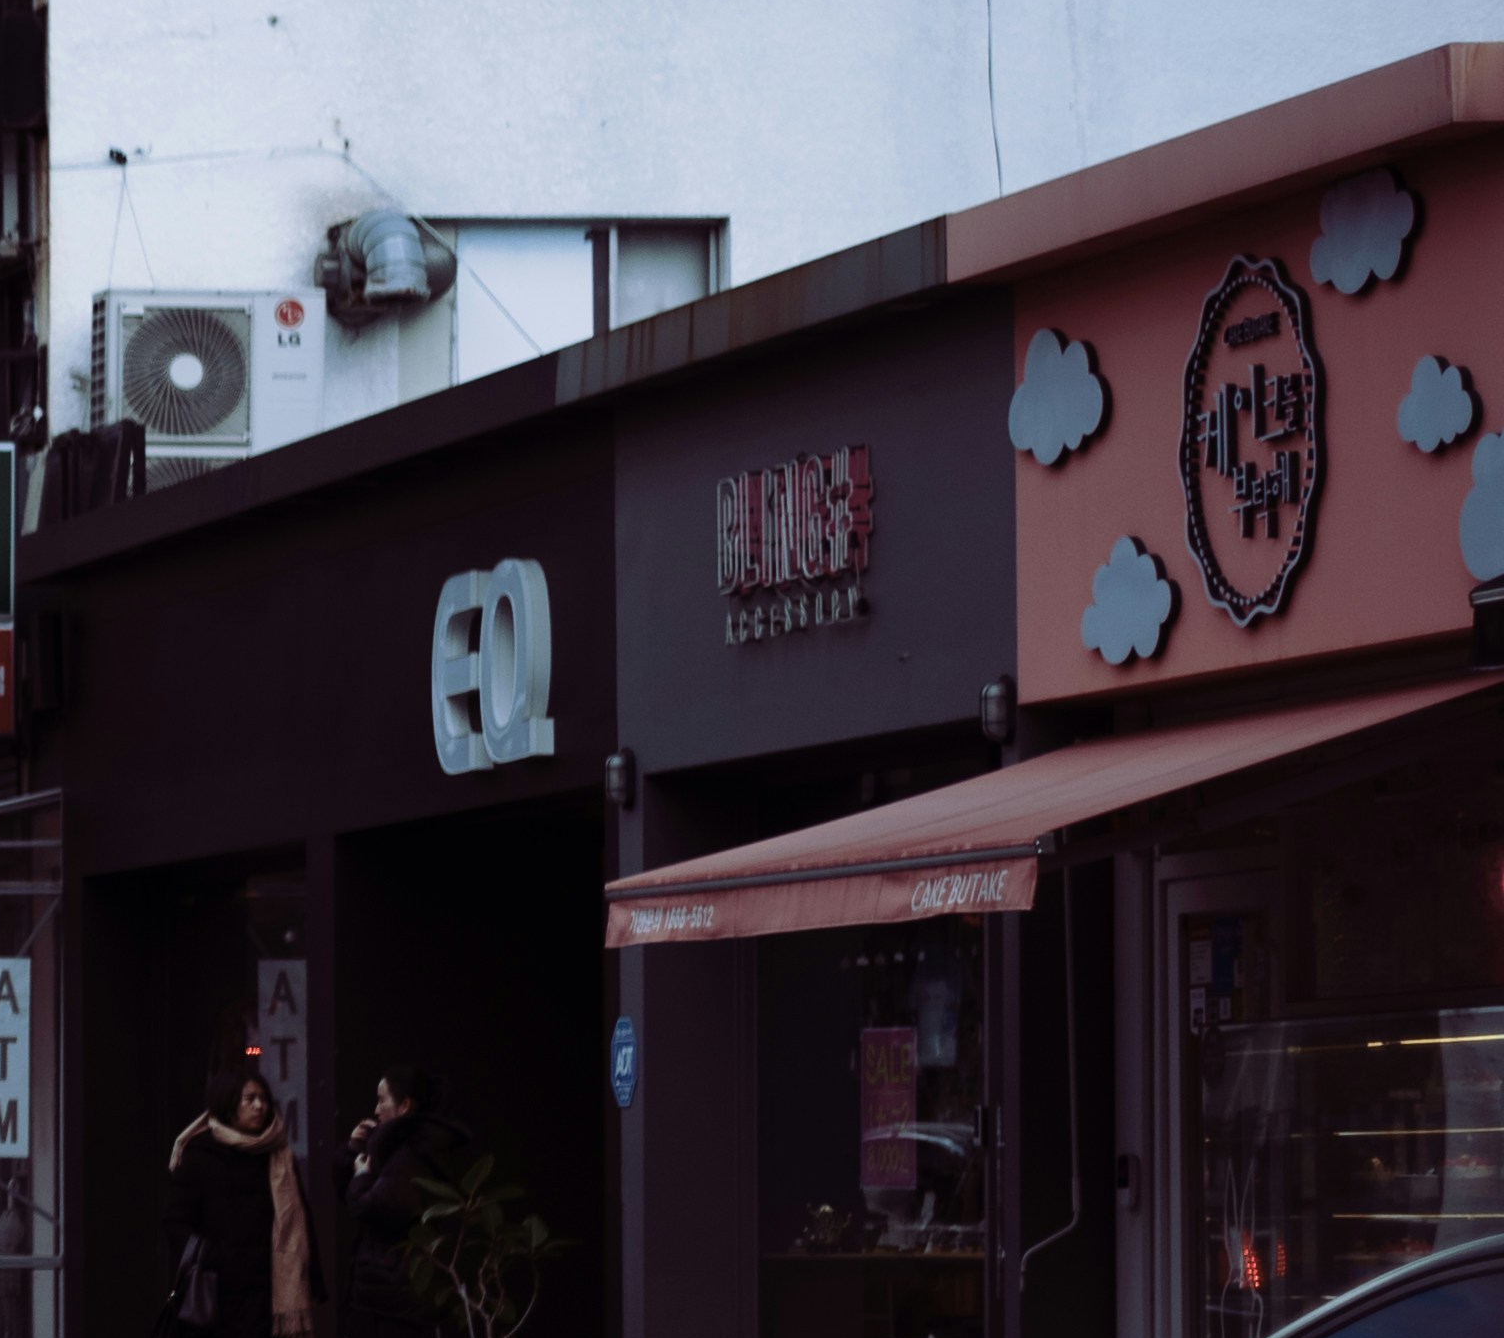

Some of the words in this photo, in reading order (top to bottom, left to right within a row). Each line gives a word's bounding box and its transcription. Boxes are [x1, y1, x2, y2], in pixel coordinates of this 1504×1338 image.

[276, 333, 301, 349] LG
[911, 869, 1009, 911] CAKE'BUTAKE
[614, 1045, 634, 1077] ADT
[865, 1043, 913, 1085] SALE
